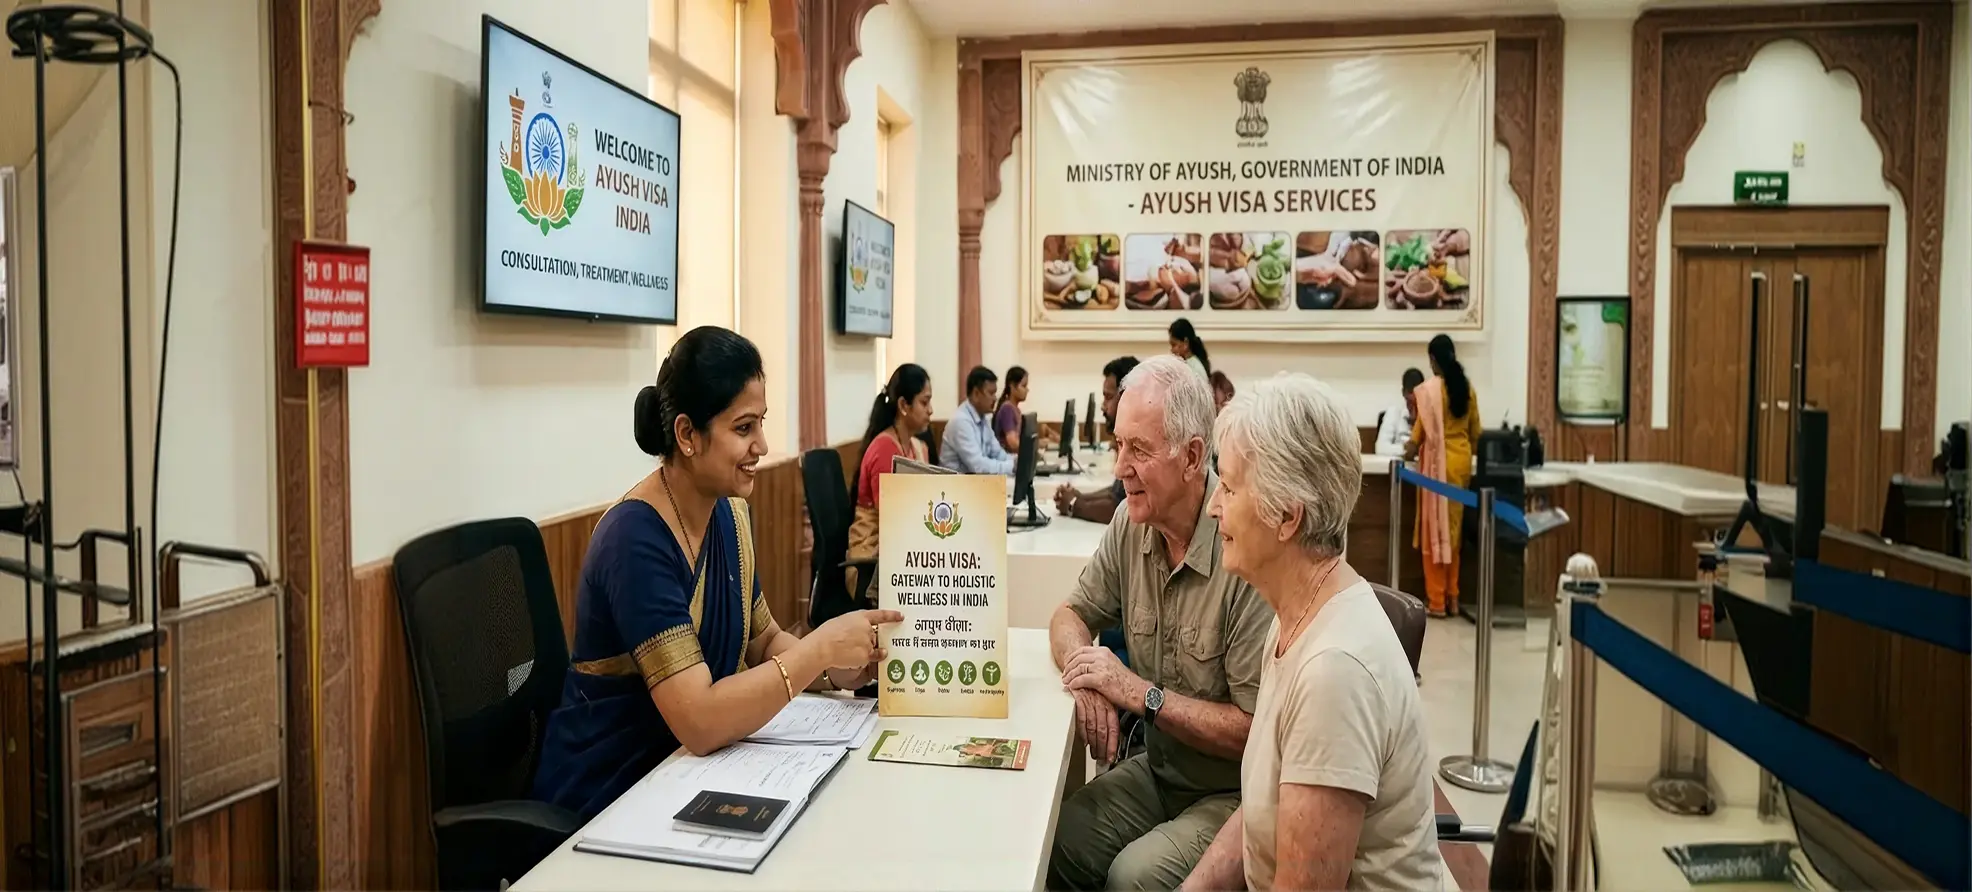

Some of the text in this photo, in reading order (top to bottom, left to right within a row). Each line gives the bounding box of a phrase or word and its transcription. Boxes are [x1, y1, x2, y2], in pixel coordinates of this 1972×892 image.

[595, 128, 671, 176] WELCOME TO
[1066, 156, 1445, 182] MINISTRY OF AYUSH, GOVERNMENT OF INDIA
[595, 164, 669, 209] AYUSH VISA
[1140, 191, 1212, 215] AYUSH
[1218, 190, 1267, 213] VISA
[1273, 188, 1377, 213] SERVICES
[615, 204, 651, 235] INDIA
[501, 250, 579, 280] CONSULTATION,
[580, 263, 631, 287] TREATMENT,
[905, 551, 981, 570] AYUSH VISA:
[891, 573, 996, 589] GATEWAY TO HOLISTIC
[897, 592, 989, 607] WELLNESS IN INDIA
